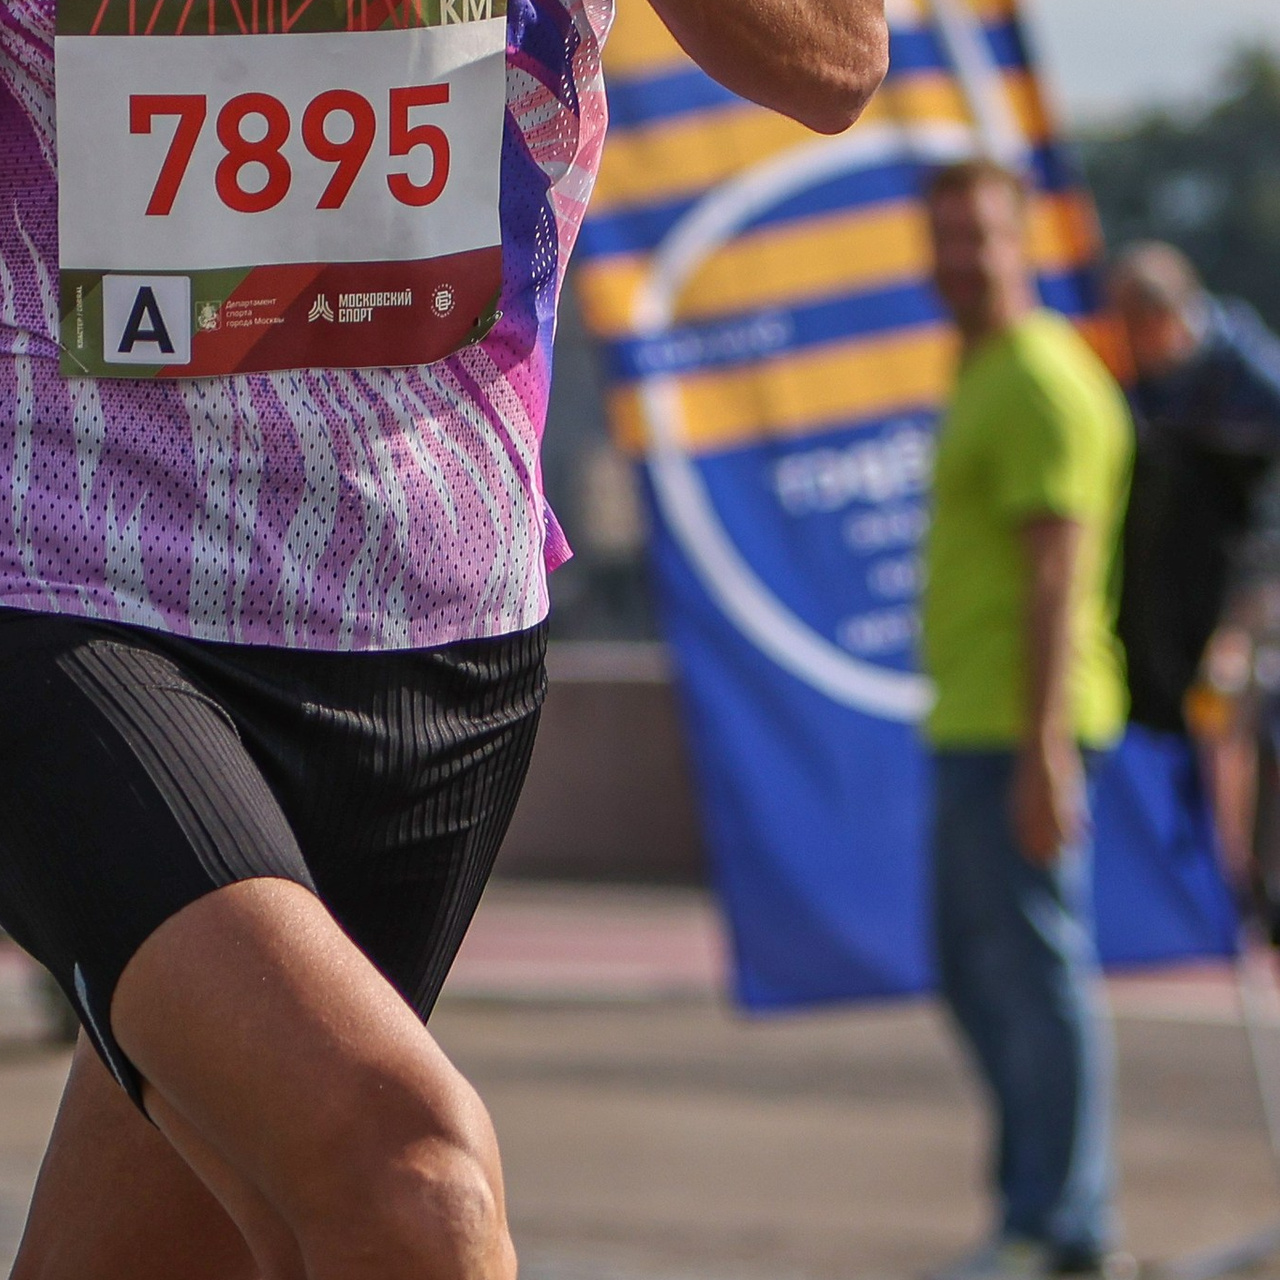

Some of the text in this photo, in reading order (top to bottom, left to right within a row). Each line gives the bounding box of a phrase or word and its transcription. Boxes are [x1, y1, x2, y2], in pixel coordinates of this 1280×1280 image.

[128, 82, 450, 216] 7895
[225, 298, 277, 310] Департамент
[338, 288, 412, 308] МОСКОВСКИЙ
[226, 310, 253, 318] спорта
[338, 307, 373, 323] СПОРТ
[226, 317, 285, 328] города Москвы
